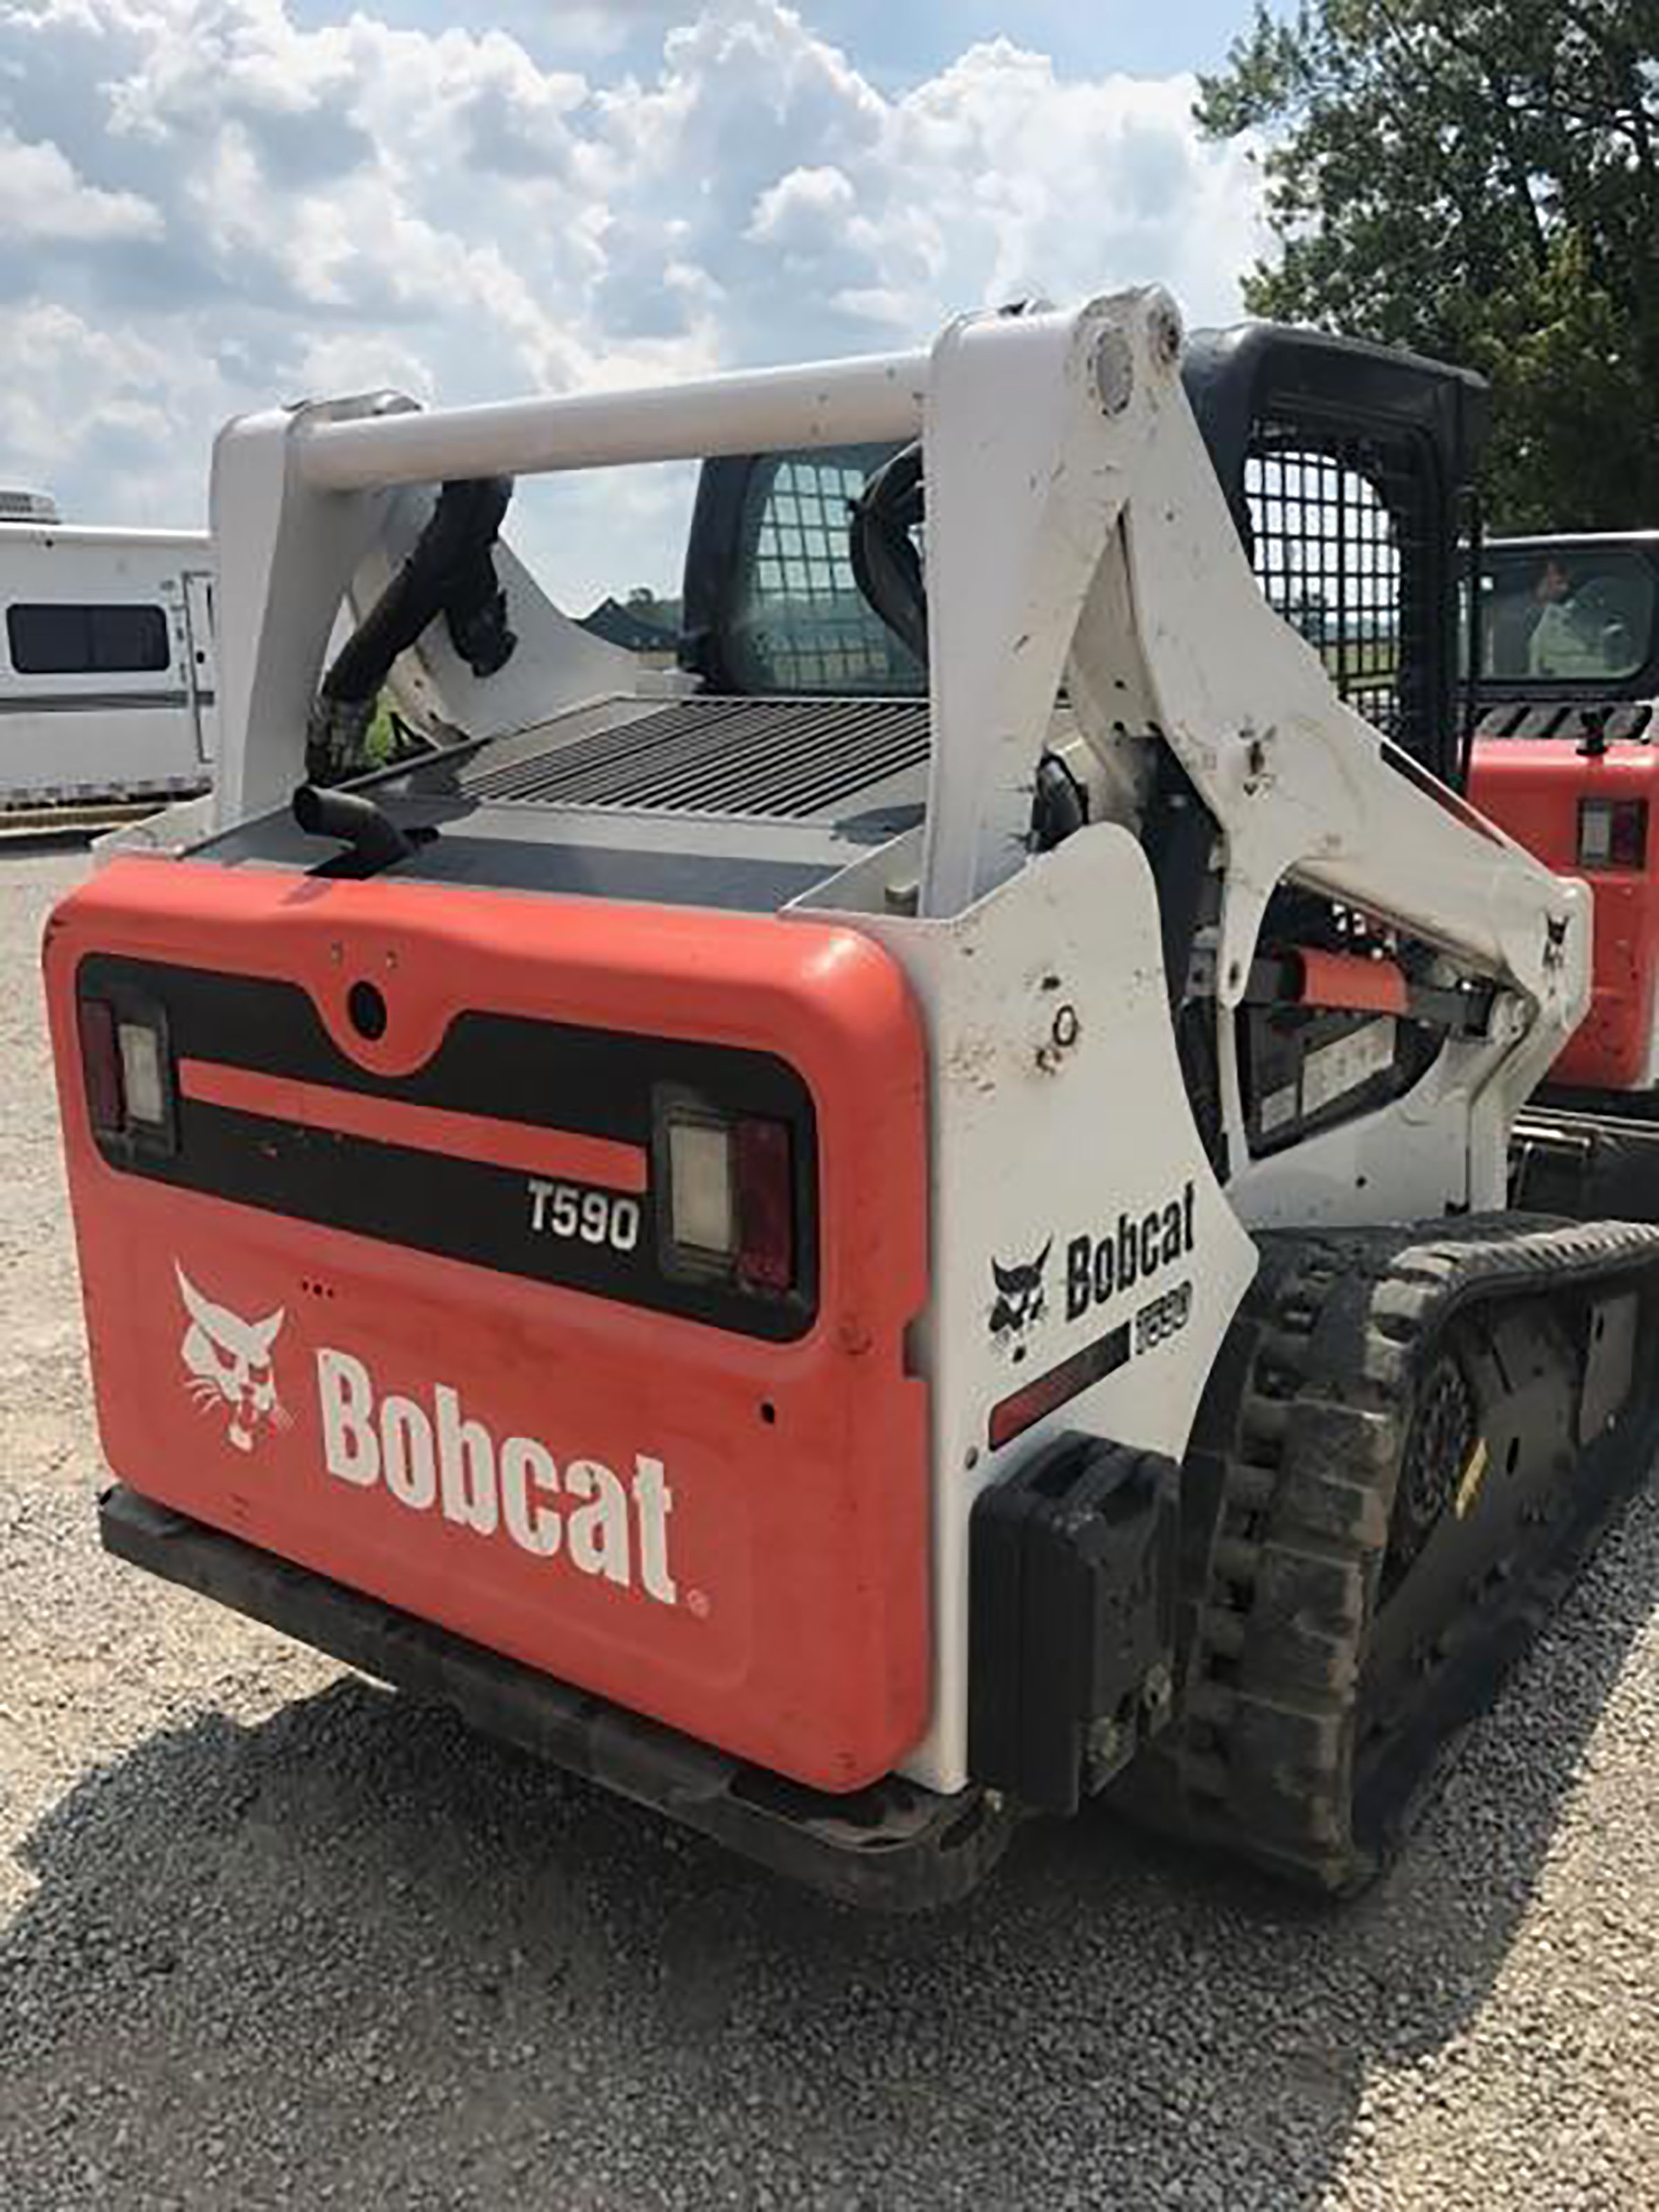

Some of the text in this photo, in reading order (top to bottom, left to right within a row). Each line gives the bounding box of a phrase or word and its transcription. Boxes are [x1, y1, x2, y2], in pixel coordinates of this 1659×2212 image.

[528, 1181, 640, 1250] T590
[1067, 1181, 1194, 1322] Bobcat
[316, 1348, 677, 1604] Bobcat
